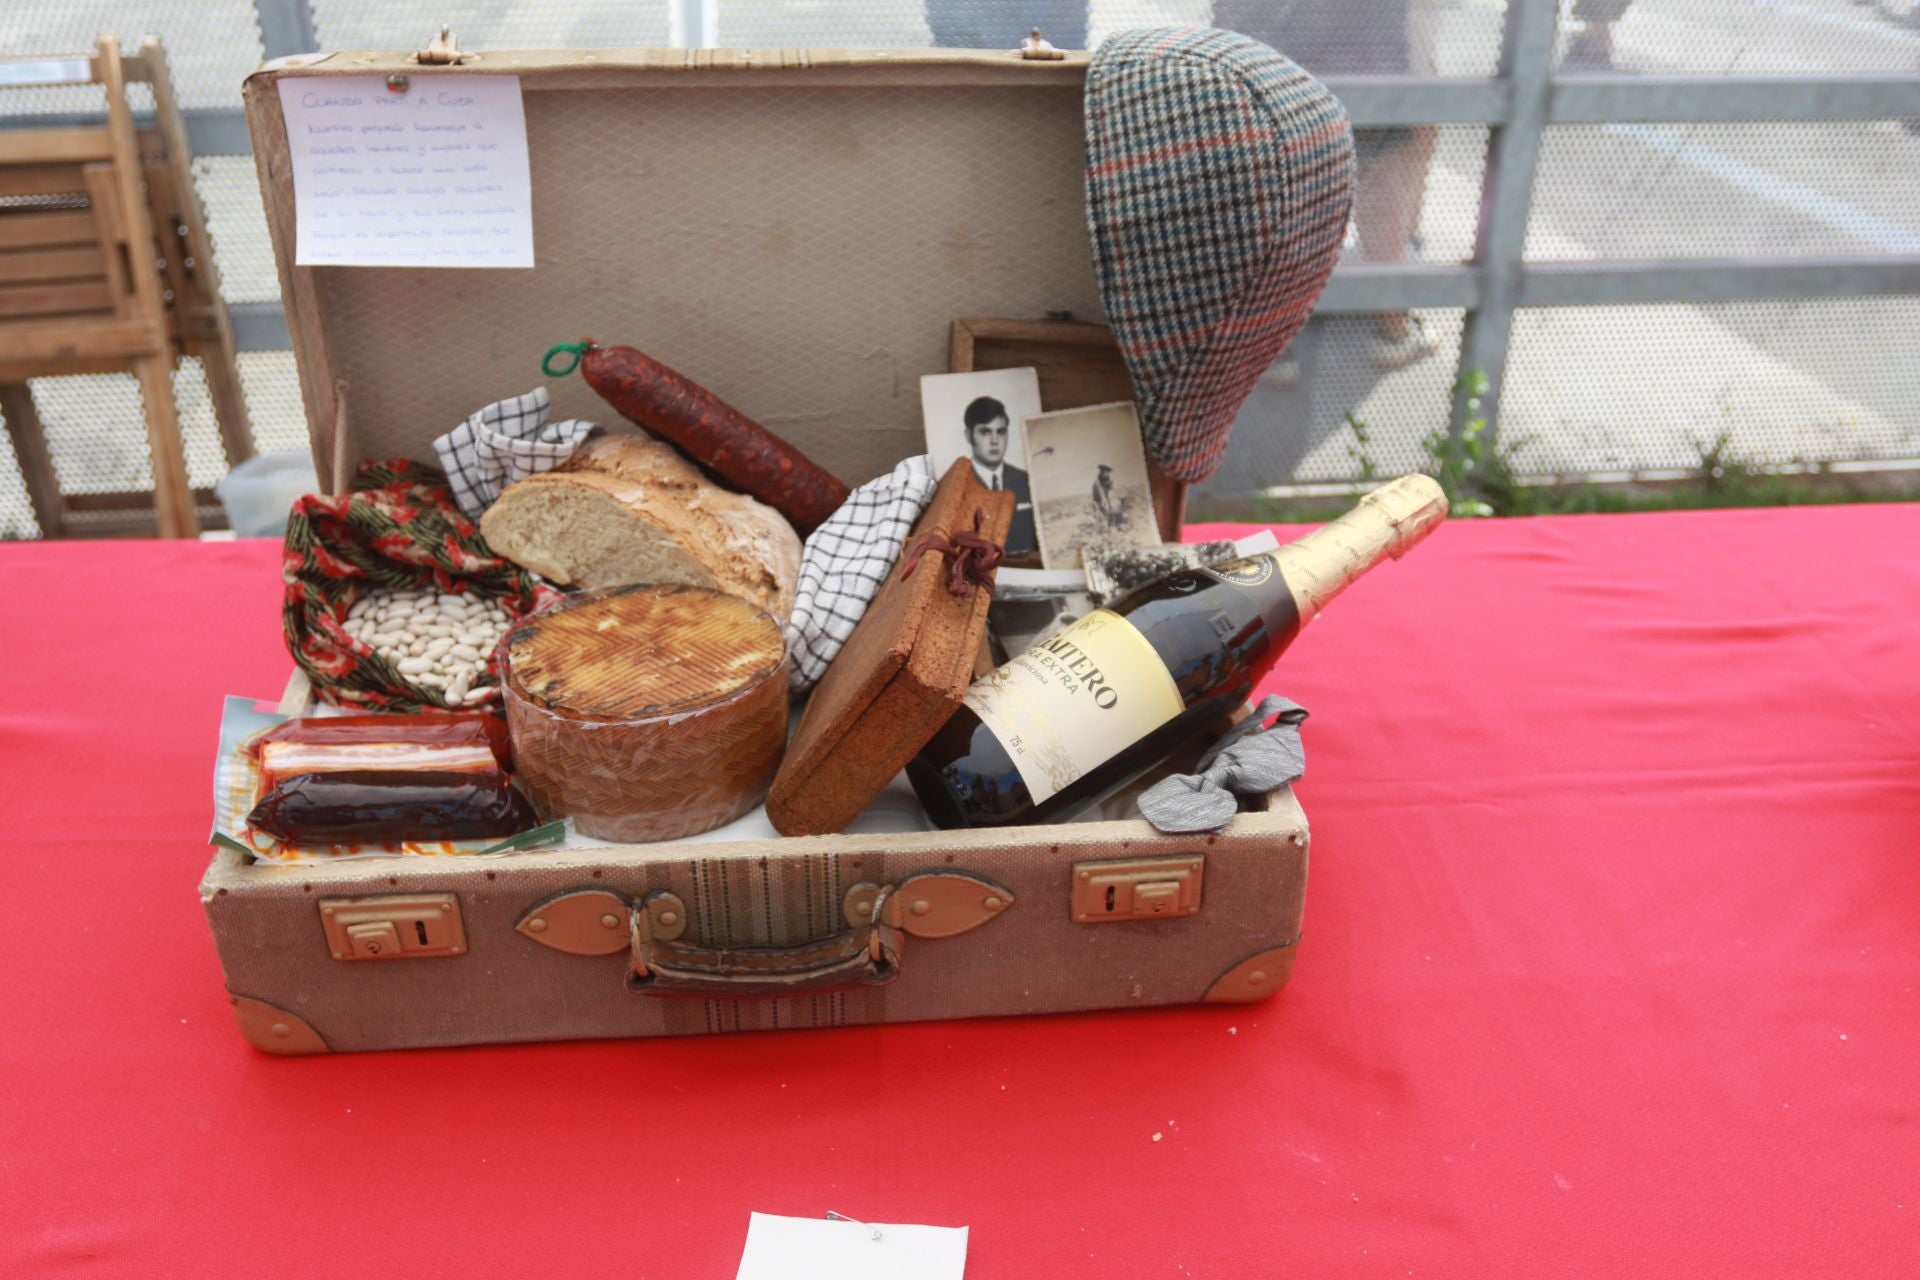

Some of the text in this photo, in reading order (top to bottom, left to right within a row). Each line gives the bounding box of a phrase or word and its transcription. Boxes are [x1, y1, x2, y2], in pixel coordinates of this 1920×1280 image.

[301, 91, 363, 108] CUANDO
[1040, 656, 1079, 695] EXTRA
[1009, 734, 1022, 748] 75
